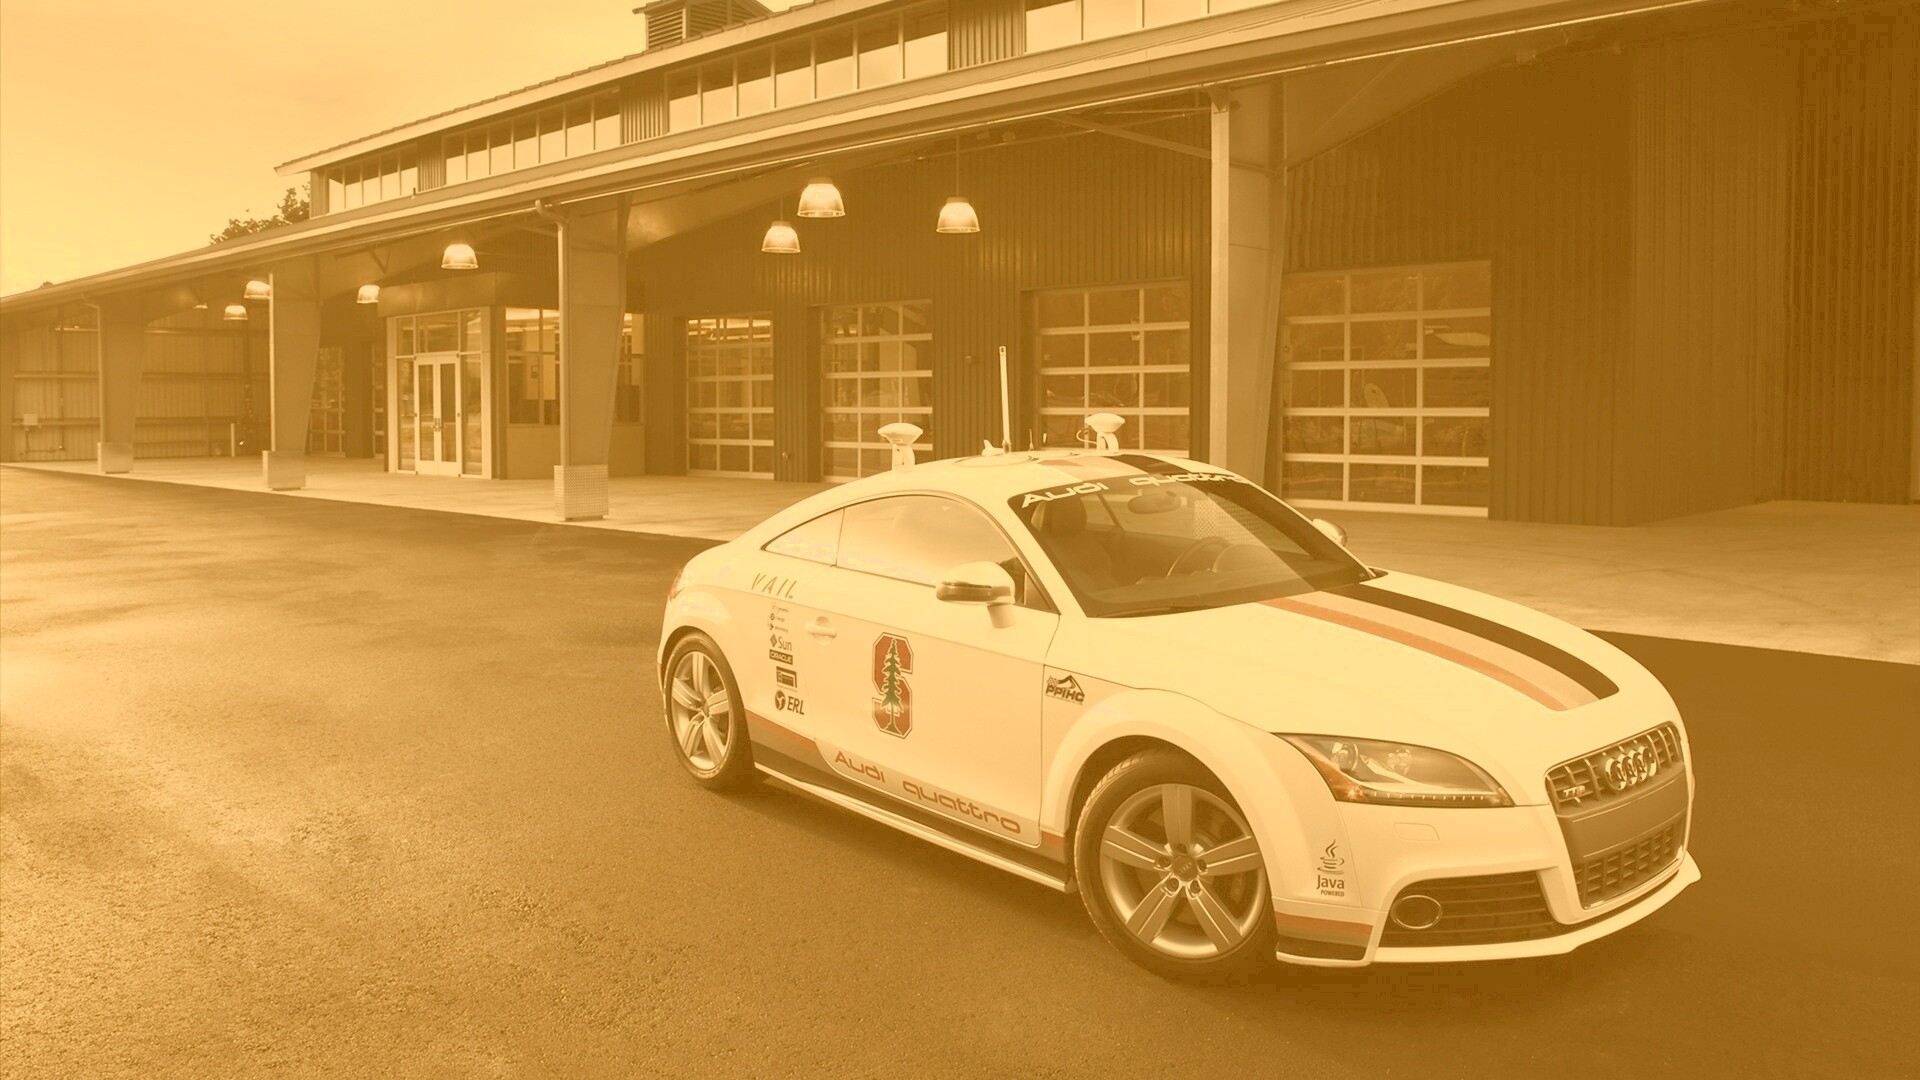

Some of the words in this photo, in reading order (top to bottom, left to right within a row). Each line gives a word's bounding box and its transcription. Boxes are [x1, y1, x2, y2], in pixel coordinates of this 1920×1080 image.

[1021, 482, 1109, 508] Audi
[778, 636, 792, 651] Sun
[770, 651, 793, 664] ORACLE
[1045, 685, 1084, 702] PPIHC
[787, 696, 804, 715] ERL
[835, 751, 886, 783] Audi
[902, 780, 1021, 834] quattro
[1316, 874, 1345, 889] Java
